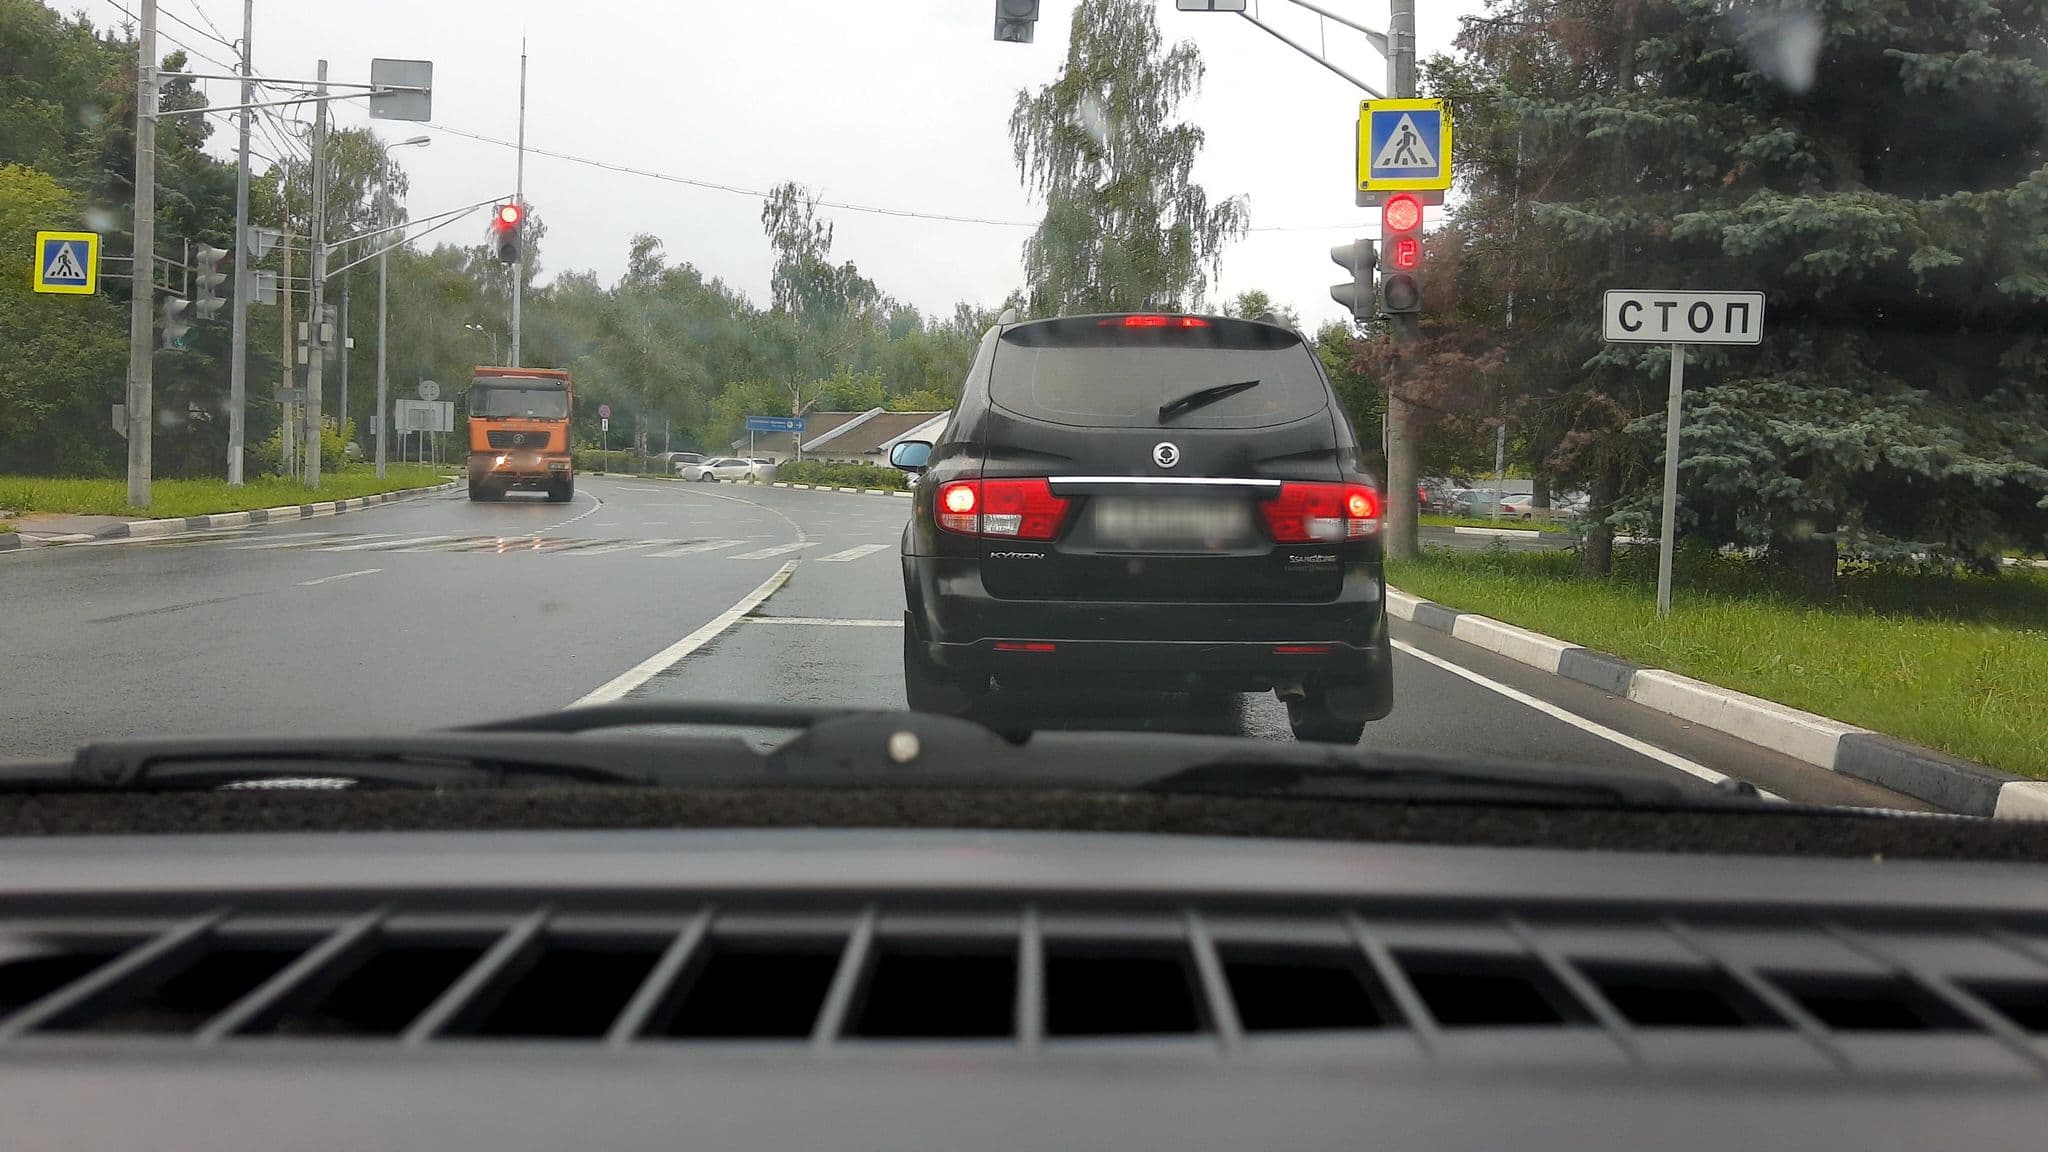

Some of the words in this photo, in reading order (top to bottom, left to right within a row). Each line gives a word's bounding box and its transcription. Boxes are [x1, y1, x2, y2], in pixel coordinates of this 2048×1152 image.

[1398, 240, 1415, 267] 12
[1618, 300, 1750, 335] СТОП
[990, 552, 1045, 560] KYRON
